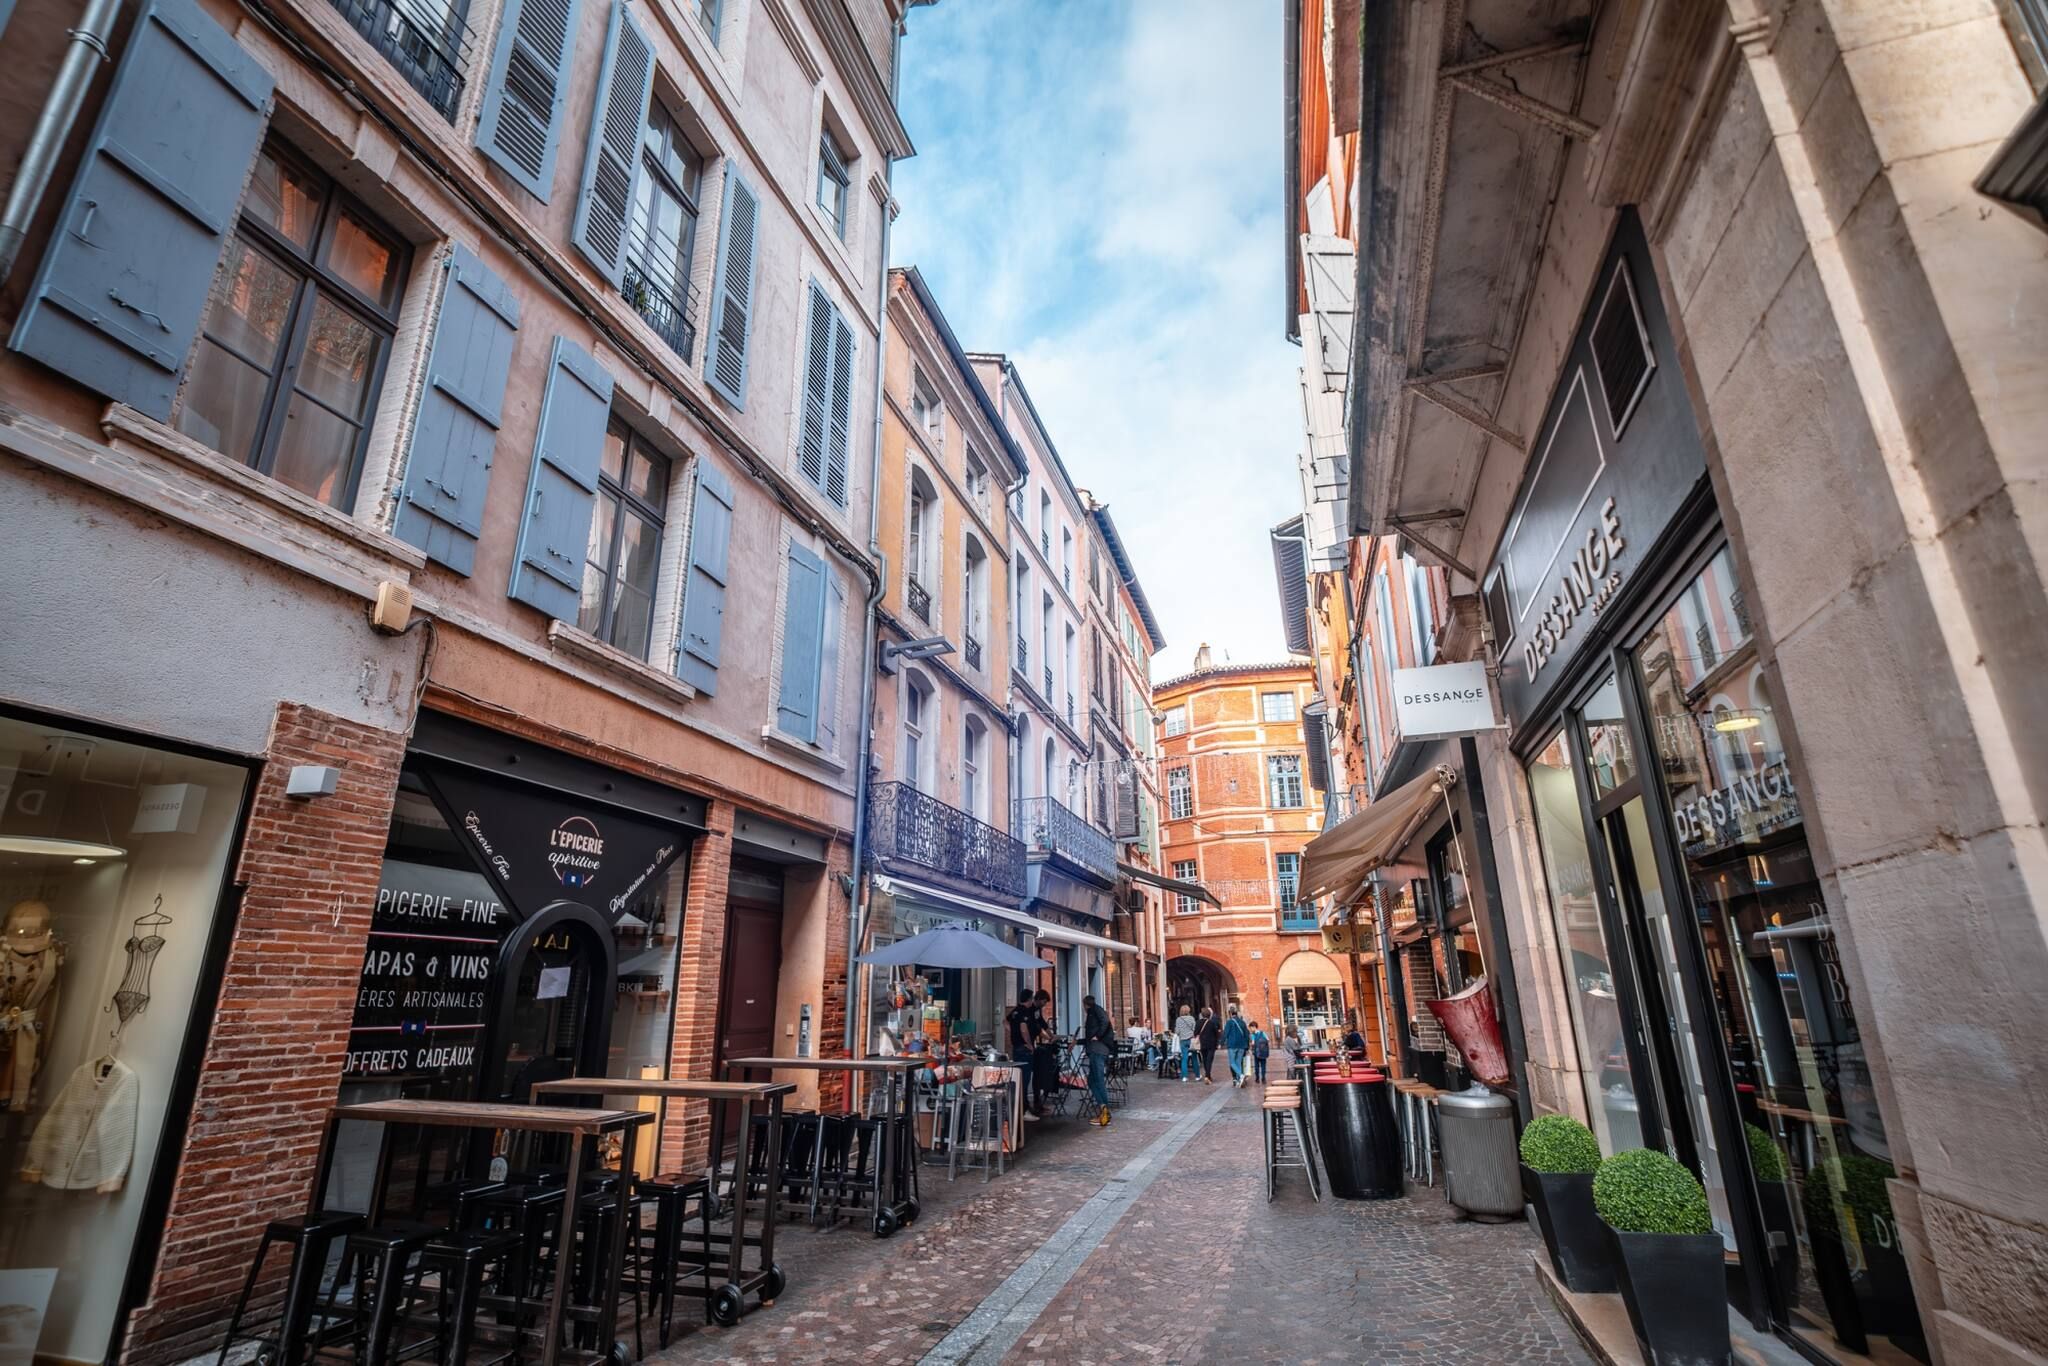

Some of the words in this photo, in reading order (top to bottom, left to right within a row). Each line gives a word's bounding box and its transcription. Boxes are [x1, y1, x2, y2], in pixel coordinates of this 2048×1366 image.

[1524, 496, 1625, 685] DESSANGE
[1404, 688, 1484, 705] DESSANGE
[550, 828, 604, 855] L'EPICERIE
[492, 855, 511, 881] Fine
[376, 888, 451, 920] PICERIE
[461, 899, 499, 925] FINE
[363, 950, 416, 978] APAS
[450, 955, 490, 980] VINS
[358, 987, 396, 1008] ÈRES
[403, 991, 485, 1009] ARTISANALES
[416, 1046, 475, 1068] CADEAUX
